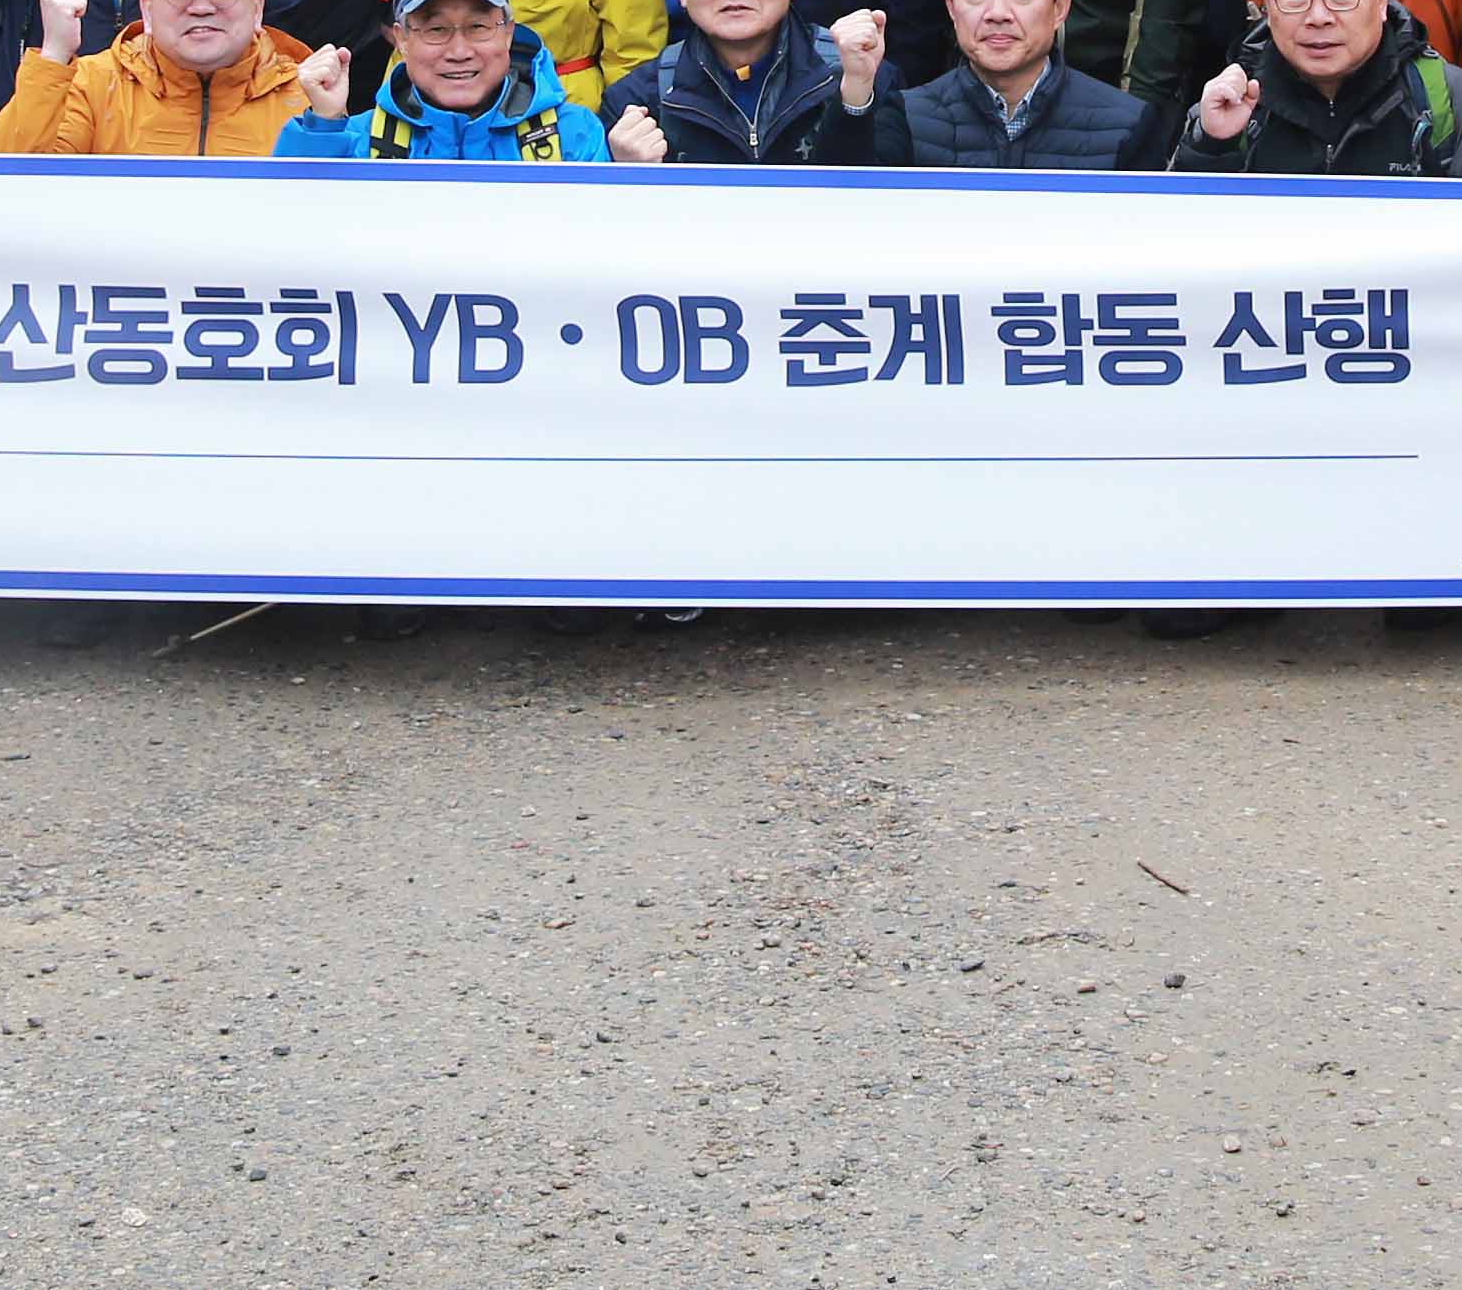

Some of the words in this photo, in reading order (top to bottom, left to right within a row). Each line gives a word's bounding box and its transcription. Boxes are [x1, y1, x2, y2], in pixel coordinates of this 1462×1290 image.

[381, 292, 525, 385] YB
[616, 293, 750, 386] OB
[778, 292, 965, 388] 춘계
[990, 291, 1188, 387] 합동
[1212, 287, 1412, 386] 산행
